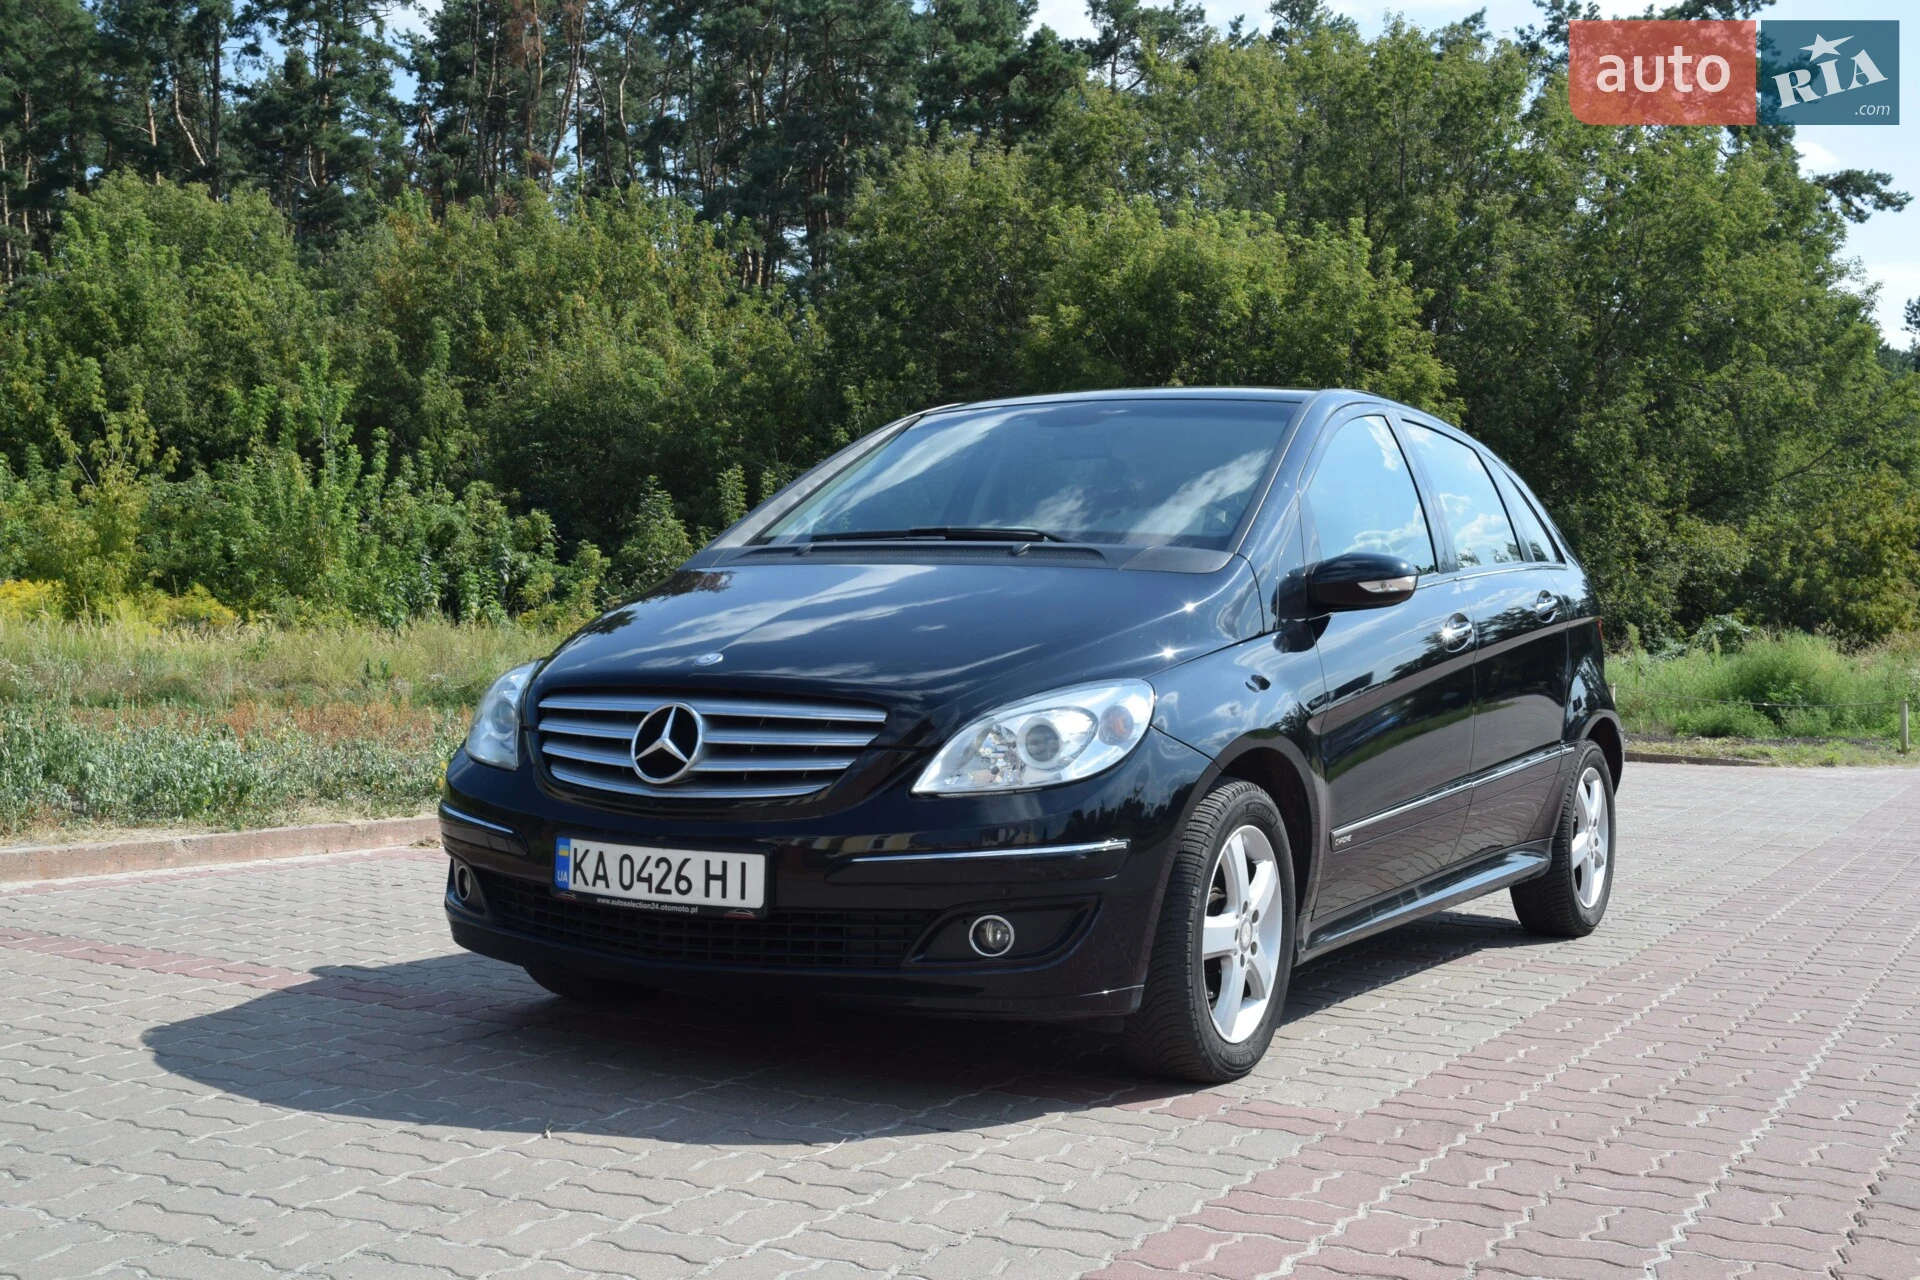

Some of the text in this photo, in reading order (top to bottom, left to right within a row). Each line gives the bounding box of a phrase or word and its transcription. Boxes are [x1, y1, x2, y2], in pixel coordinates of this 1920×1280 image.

[557, 870, 568, 883] UA
[573, 847, 610, 889] KA
[618, 853, 693, 896] 0426
[597, 897, 698, 914] www.autoselection24.otomoto.pl
